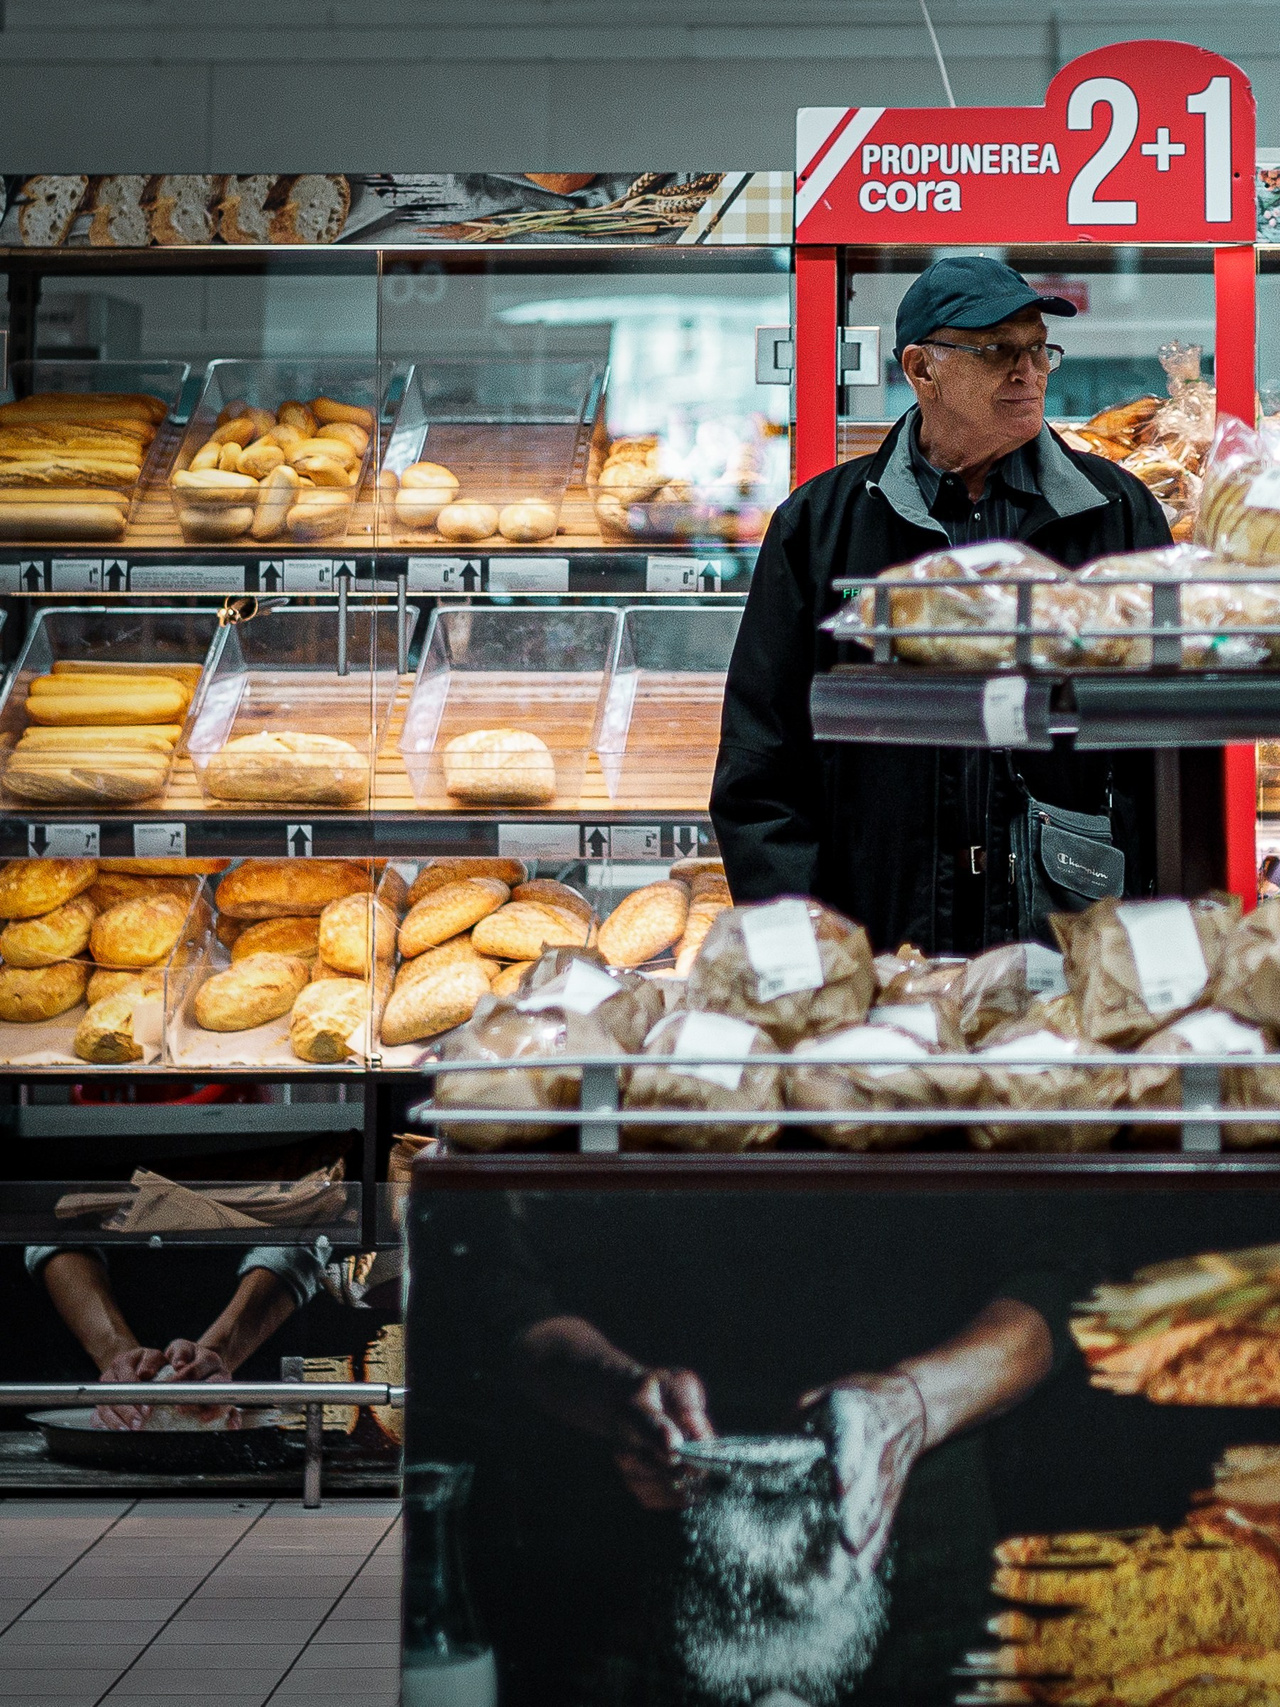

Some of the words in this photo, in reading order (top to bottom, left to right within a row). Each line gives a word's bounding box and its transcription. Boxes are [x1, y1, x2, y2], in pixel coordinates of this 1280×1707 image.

[861, 143, 1060, 175] PROPUNEREA
[1066, 76, 1233, 225] 2+1
[858, 179, 962, 213] cora
